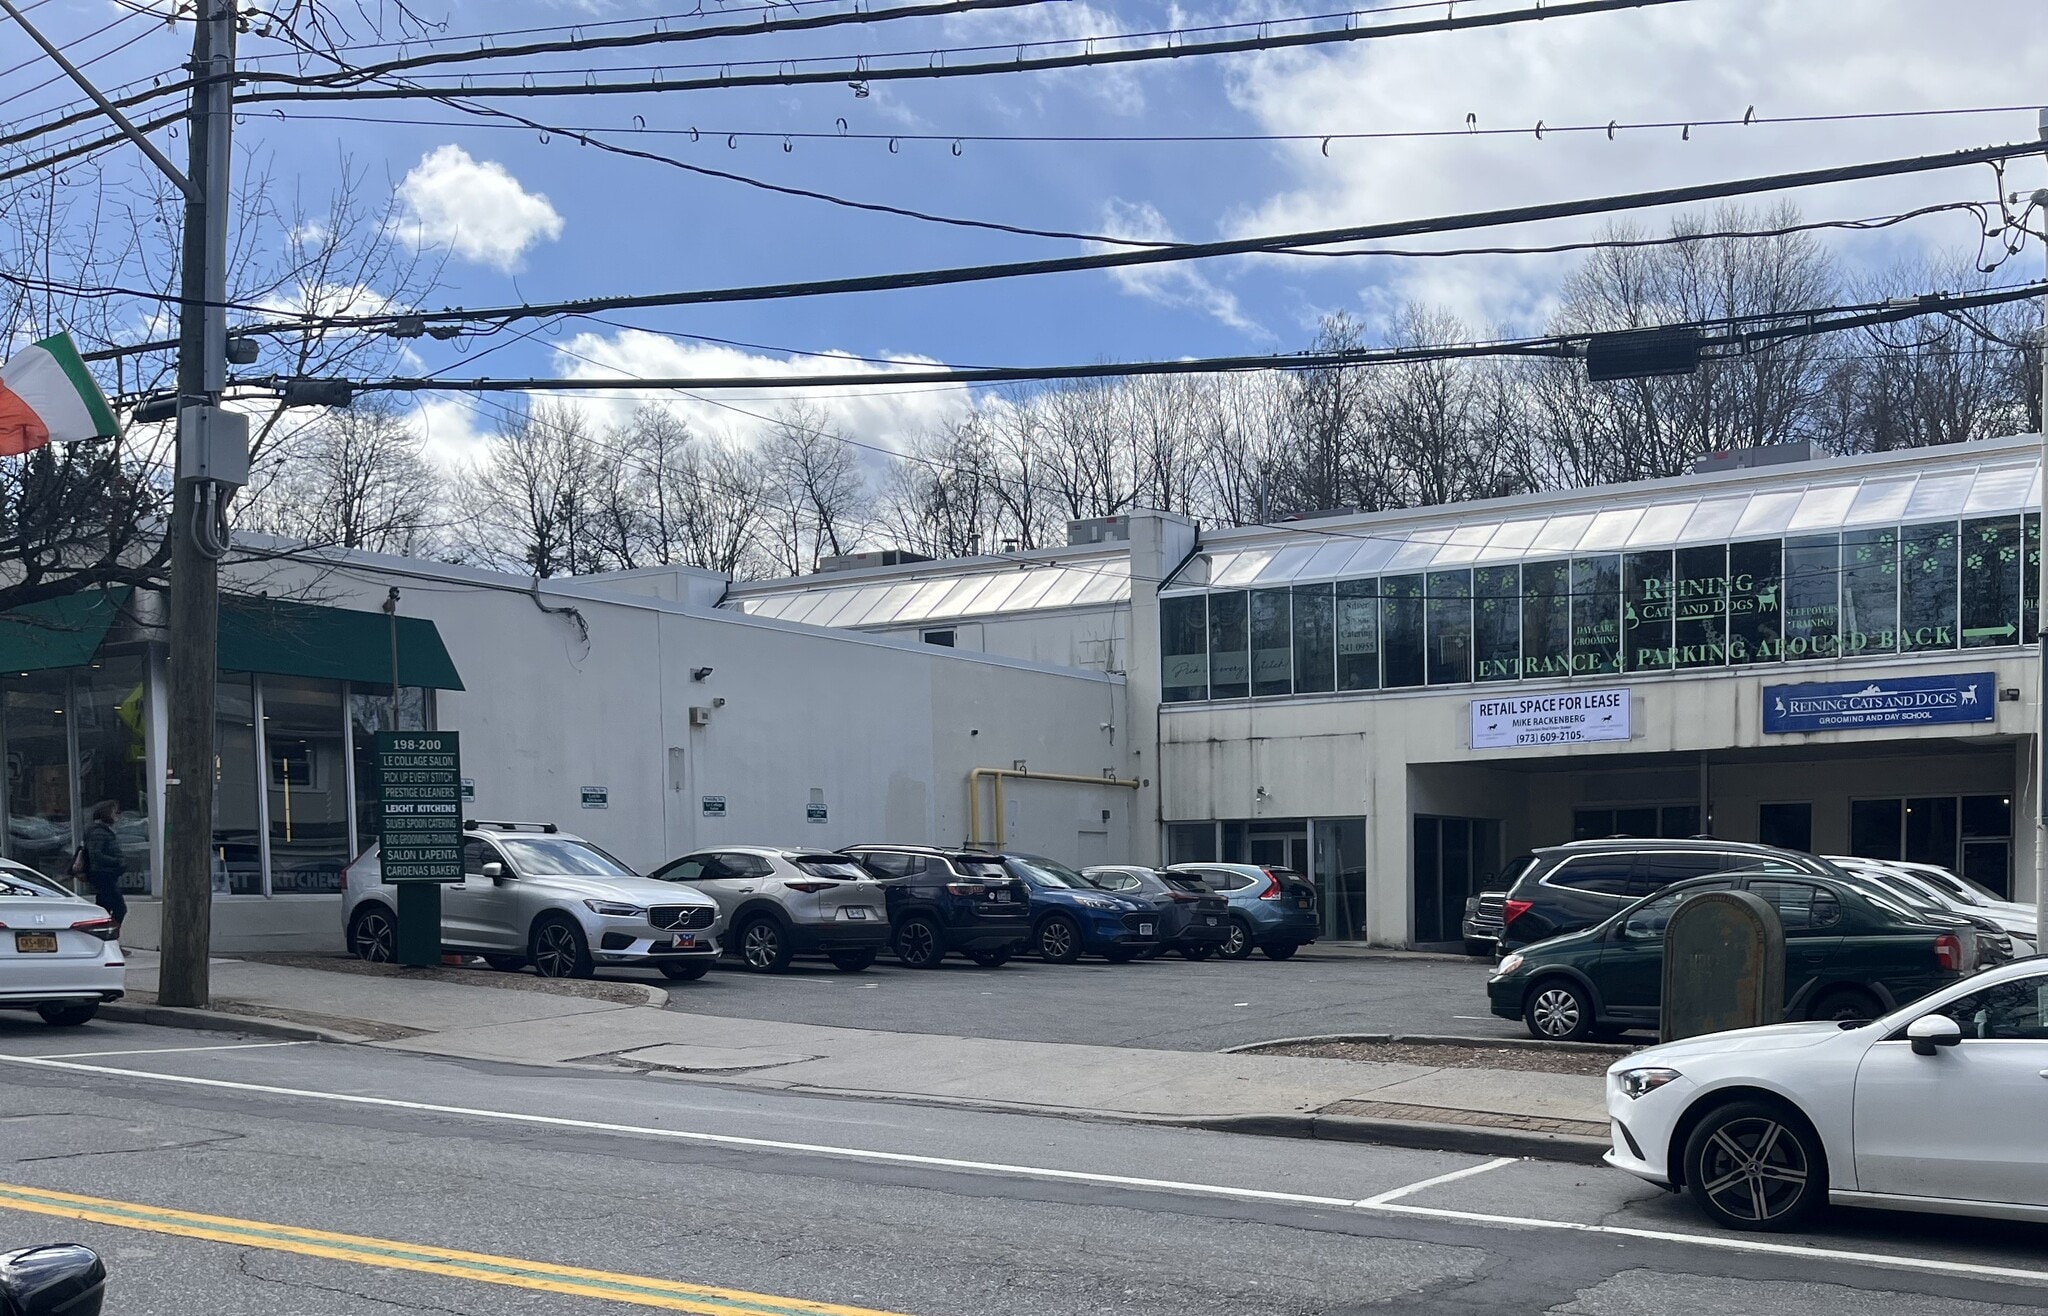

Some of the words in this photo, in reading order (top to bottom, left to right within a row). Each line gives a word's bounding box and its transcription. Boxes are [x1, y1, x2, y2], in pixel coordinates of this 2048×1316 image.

[1642, 605, 1674, 618] CAT
[1681, 603, 1709, 615] AND
[1791, 618, 1834, 629] TRAINING
[1577, 626, 1592, 635] DAY
[1594, 624, 1615, 634] CARE
[1573, 635, 1618, 646] GROOMING
[1478, 652, 1602, 678] ENTRANCE
[1612, 650, 1627, 668] &
[1637, 641, 1746, 667] PARKING
[1756, 632, 1868, 657] AROUND
[1880, 626, 1953, 649] BACK
[1479, 703, 1518, 717] RETAIL
[1520, 699, 1556, 714] SPACE
[1558, 696, 1582, 711] FOR
[1584, 693, 1620, 709] LEASE
[1790, 699, 1847, 714] REINING
[1849, 696, 1883, 710] CATS
[1885, 696, 1913, 707] AND
[1915, 692, 1957, 706] DOGS
[1512, 717, 1532, 727] MIKE
[1533, 714, 1586, 726] RACKENBERG
[1819, 714, 1864, 725] GROOMING
[1865, 713, 1884, 723] AND
[1884, 712, 1900, 721] DAY
[1901, 711, 1933, 720] SCHOOL
[1516, 732, 1539, 744] (973)
[1540, 730, 1582, 742] 609-2105
[393, 739, 442, 750] 198-200
[383, 756, 394, 766] LE
[394, 755, 428, 767] COLLAGE
[429, 756, 454, 767] SALON
[384, 772, 399, 782] PICK
[400, 772, 409, 782] UP
[409, 772, 430, 783] EVERY
[430, 772, 453, 783] STITCH
[385, 787, 418, 798] PRESTIGE
[419, 787, 455, 798] CLEANERS
[385, 804, 414, 813] LEICHT
[417, 804, 456, 813] KITCHENS
[386, 818, 406, 829] SILVER
[406, 818, 427, 829] SPOON
[428, 818, 456, 829] CATERING
[386, 834, 399, 845] DOG
[387, 850, 417, 861] SALON
[419, 850, 458, 860] LAPENTA
[386, 865, 429, 876] CARDENAS
[430, 865, 460, 876] BAKERY
[272, 872, 342, 888] KITCHEN
